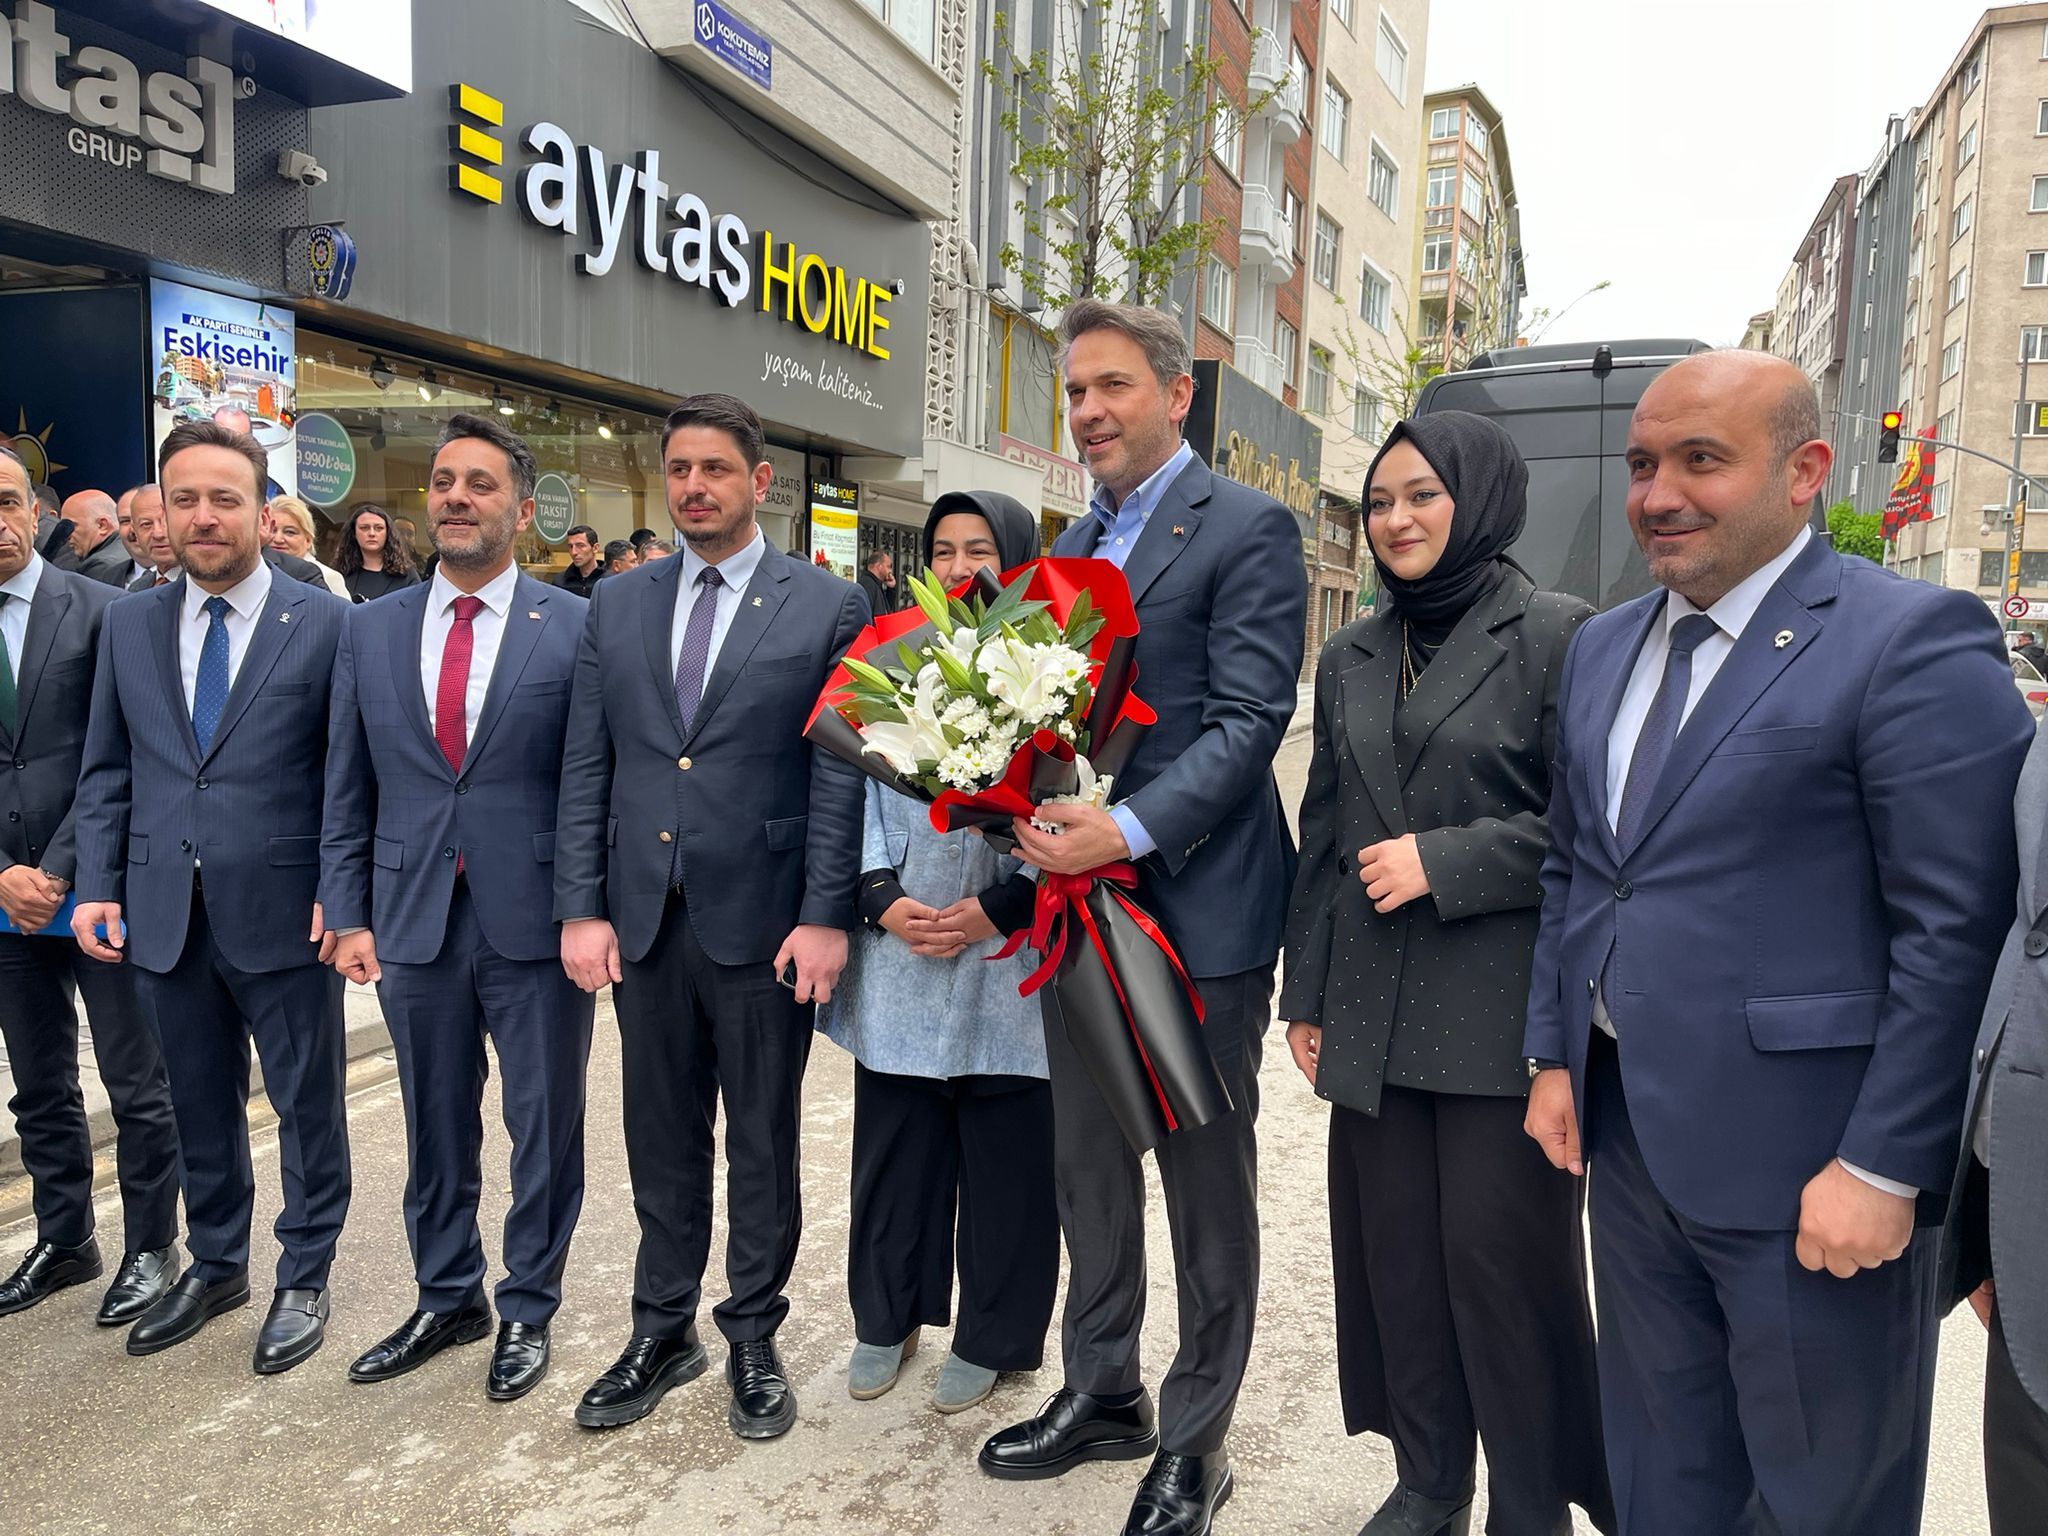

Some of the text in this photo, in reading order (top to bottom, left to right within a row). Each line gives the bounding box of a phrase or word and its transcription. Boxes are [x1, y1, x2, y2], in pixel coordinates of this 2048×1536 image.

[67, 127, 143, 169] GRUP
[517, 121, 893, 361] aytaş HOME
[188, 314, 203, 327] AK
[760, 351, 814, 388] yaşam
[296, 433, 317, 445] OLTUK
[301, 470, 341, 485] BAŞLAYAN
[780, 477, 801, 493] SATIŞ
[838, 487, 857, 501] HOME
[539, 504, 568, 519] TAKSİT
[543, 520, 564, 530] FIRSATI
